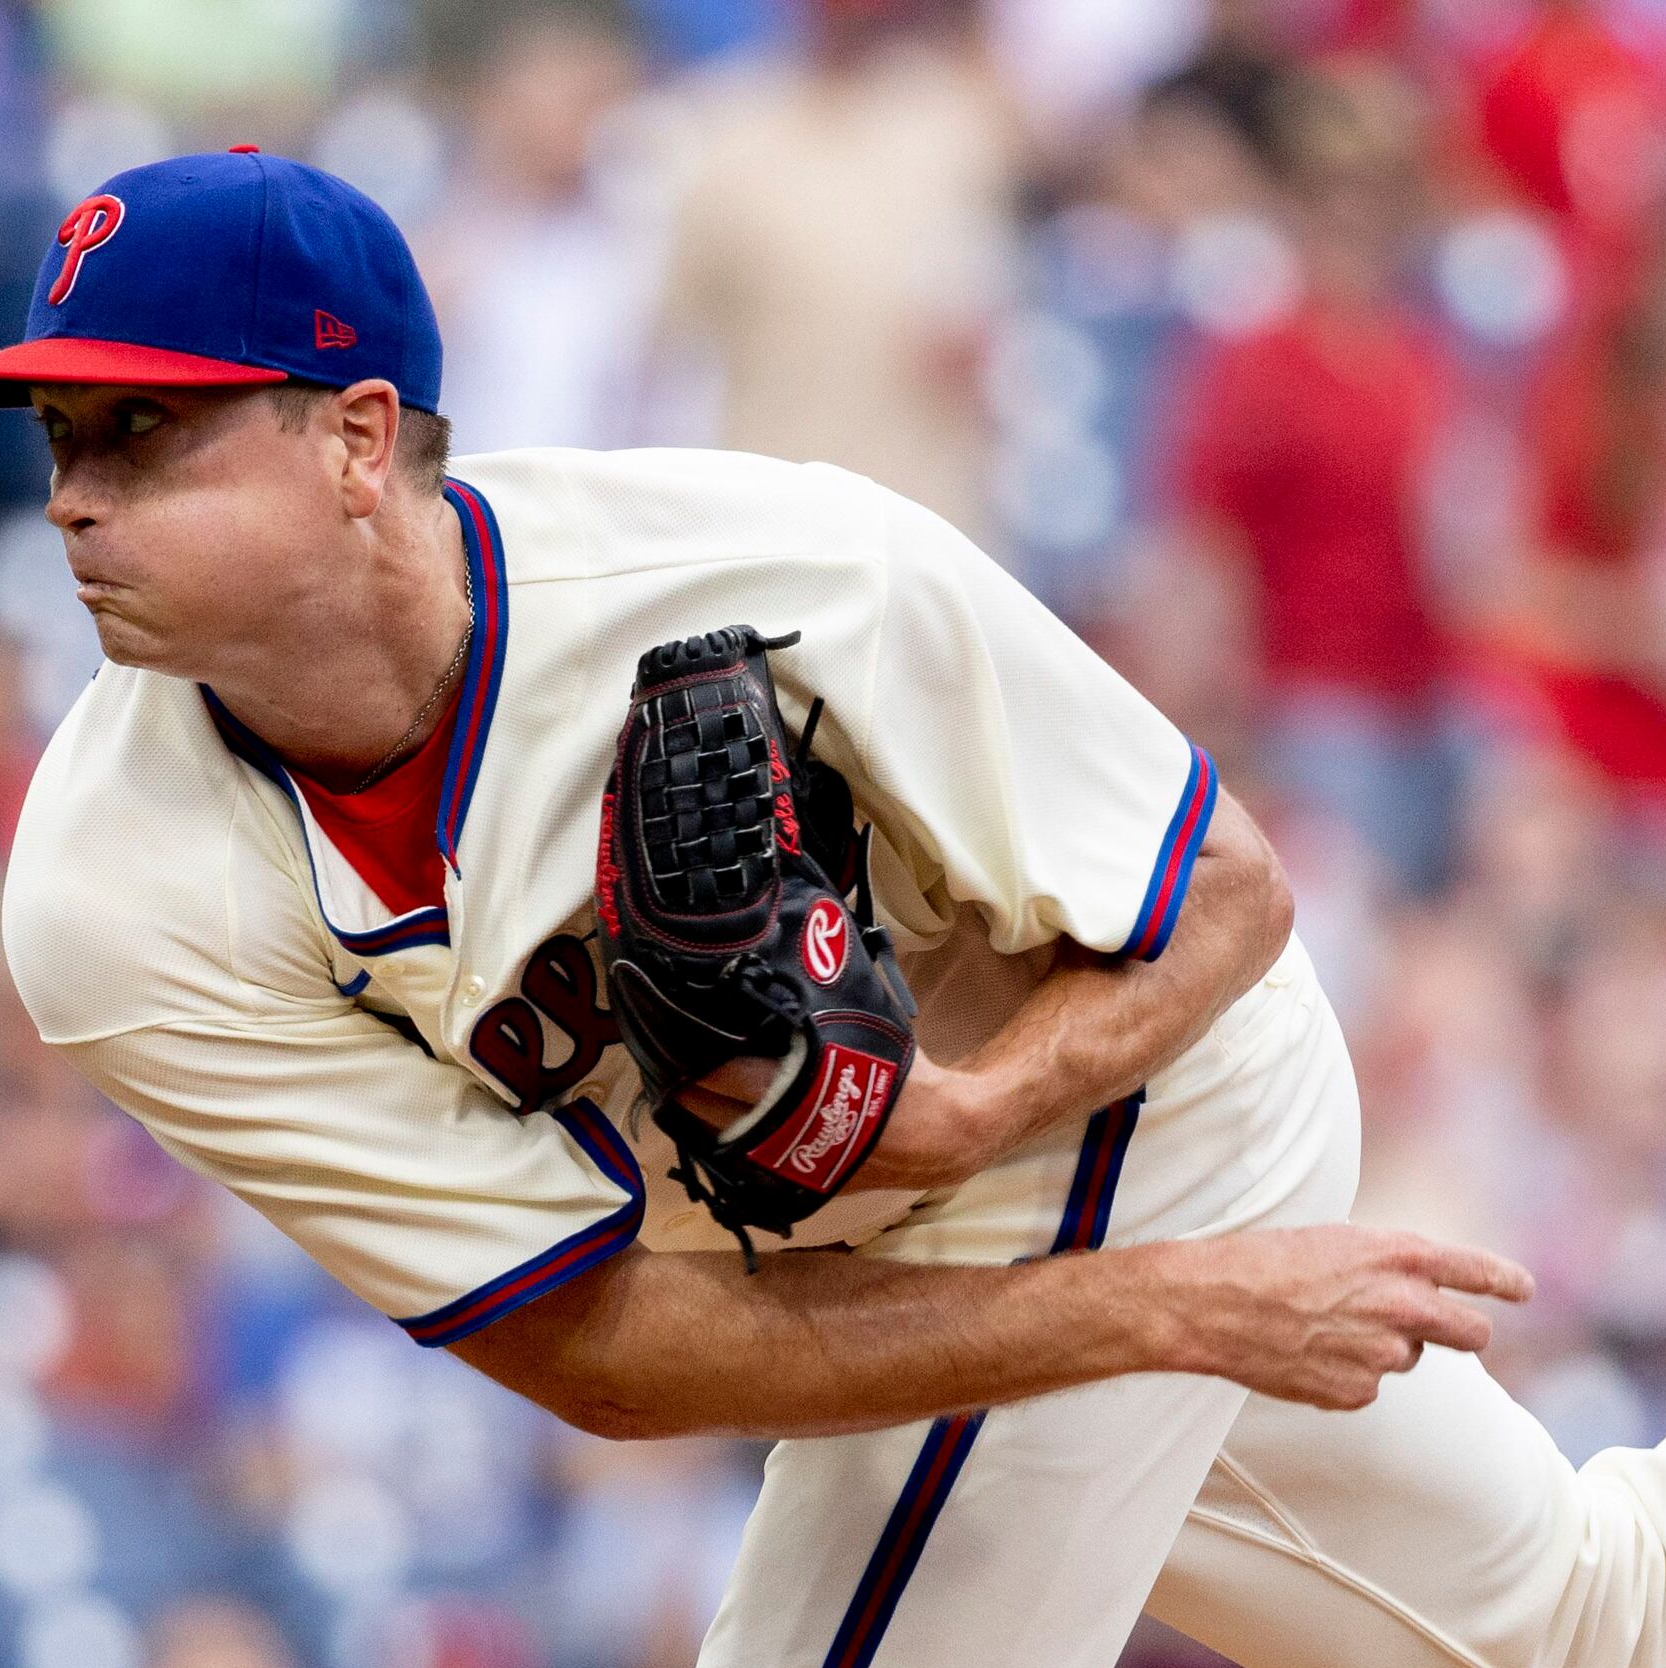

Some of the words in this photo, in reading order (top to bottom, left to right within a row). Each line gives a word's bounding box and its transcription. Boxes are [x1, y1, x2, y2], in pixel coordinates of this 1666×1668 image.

[48, 194, 125, 305] P
[807, 908, 843, 978] R
[790, 1064, 862, 1173] Rawlings
